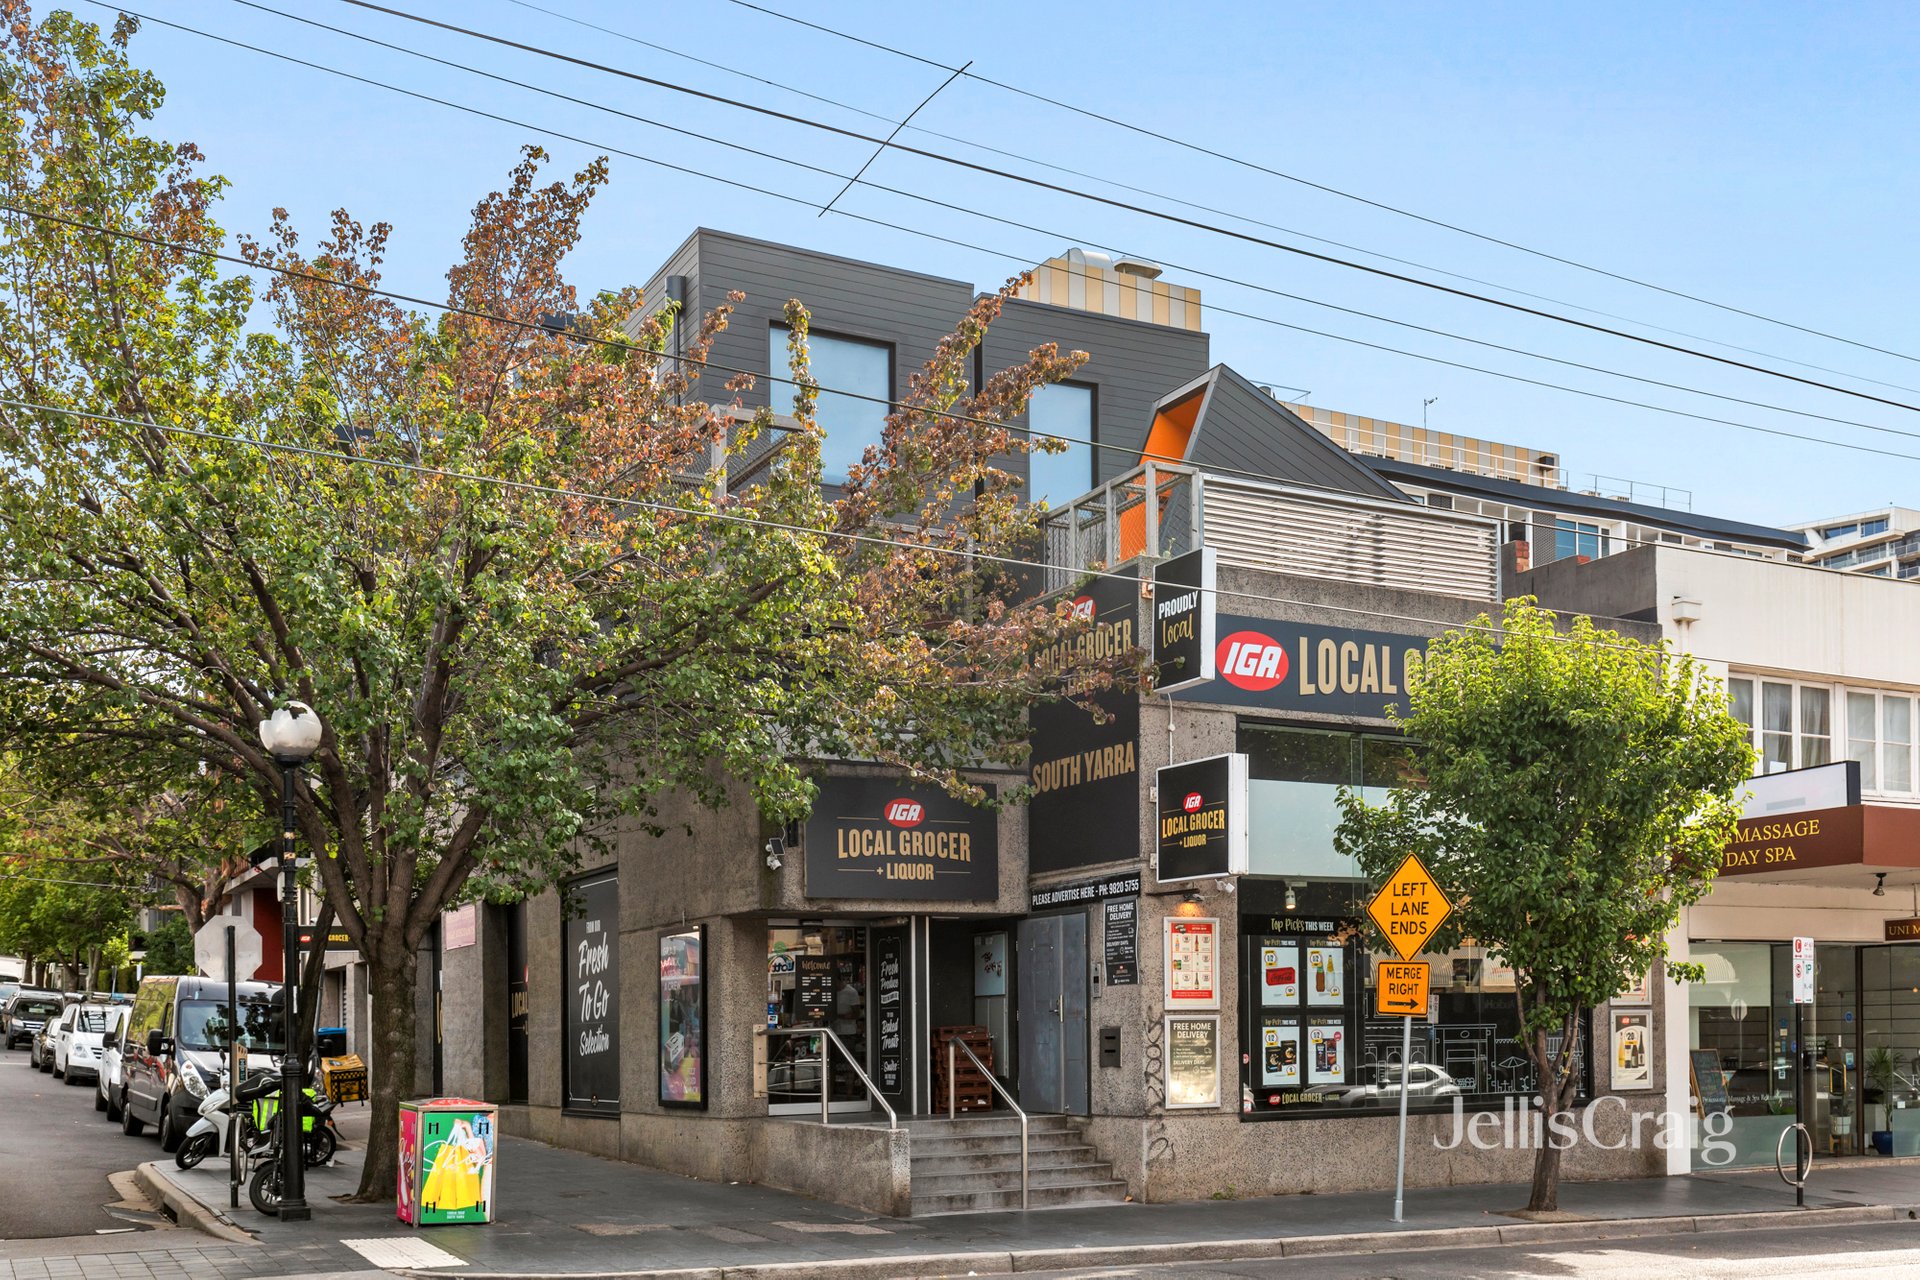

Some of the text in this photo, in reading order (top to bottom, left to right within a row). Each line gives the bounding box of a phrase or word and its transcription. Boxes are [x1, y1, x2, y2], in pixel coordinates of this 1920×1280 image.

[1159, 590, 1198, 620] PROUDLY
[1222, 642, 1282, 679] IGA
[1299, 636, 1398, 696] LOCAL
[1032, 741, 1135, 796] SOUTH YARRA
[1185, 795, 1201, 809] IGA
[888, 803, 921, 821] IGA
[1162, 809, 1225, 839] LOCAL GROCER
[1735, 819, 1820, 844] MASSAGE
[837, 829, 971, 862] LOCAL GROCER
[1183, 833, 1207, 848] LIQUOR
[1726, 846, 1797, 867] DAY SPA
[886, 863, 934, 881] LIQUOR
[1032, 892, 1051, 905] PLEASE
[1051, 888, 1080, 903] ADVERTISE
[1080, 886, 1095, 898] HERE
[1098, 884, 1108, 896] PH:
[1109, 882, 1124, 894] 9820
[1124, 879, 1139, 892] 5755
[1393, 882, 1428, 897] LEFT
[1107, 902, 1134, 913] FREE HOME
[1391, 902, 1429, 916] LANE
[1109, 911, 1132, 921] DELIVERY
[1271, 917, 1334, 932] Top Picks THIS WEEK
[1391, 921, 1427, 935] ENDS
[1888, 925, 1909, 936] UNI
[579, 931, 609, 979] Fresh
[1386, 967, 1422, 980] MERGE
[1389, 983, 1419, 995] RIGHT
[579, 980, 610, 1022] To Go
[1173, 1022, 1212, 1030] FREE HOME
[580, 1023, 610, 1056] Selection
[1177, 1030, 1209, 1039] DELIVERY
[1282, 1093, 1299, 1104] LOCAL
[1300, 1093, 1323, 1103] GROCER
